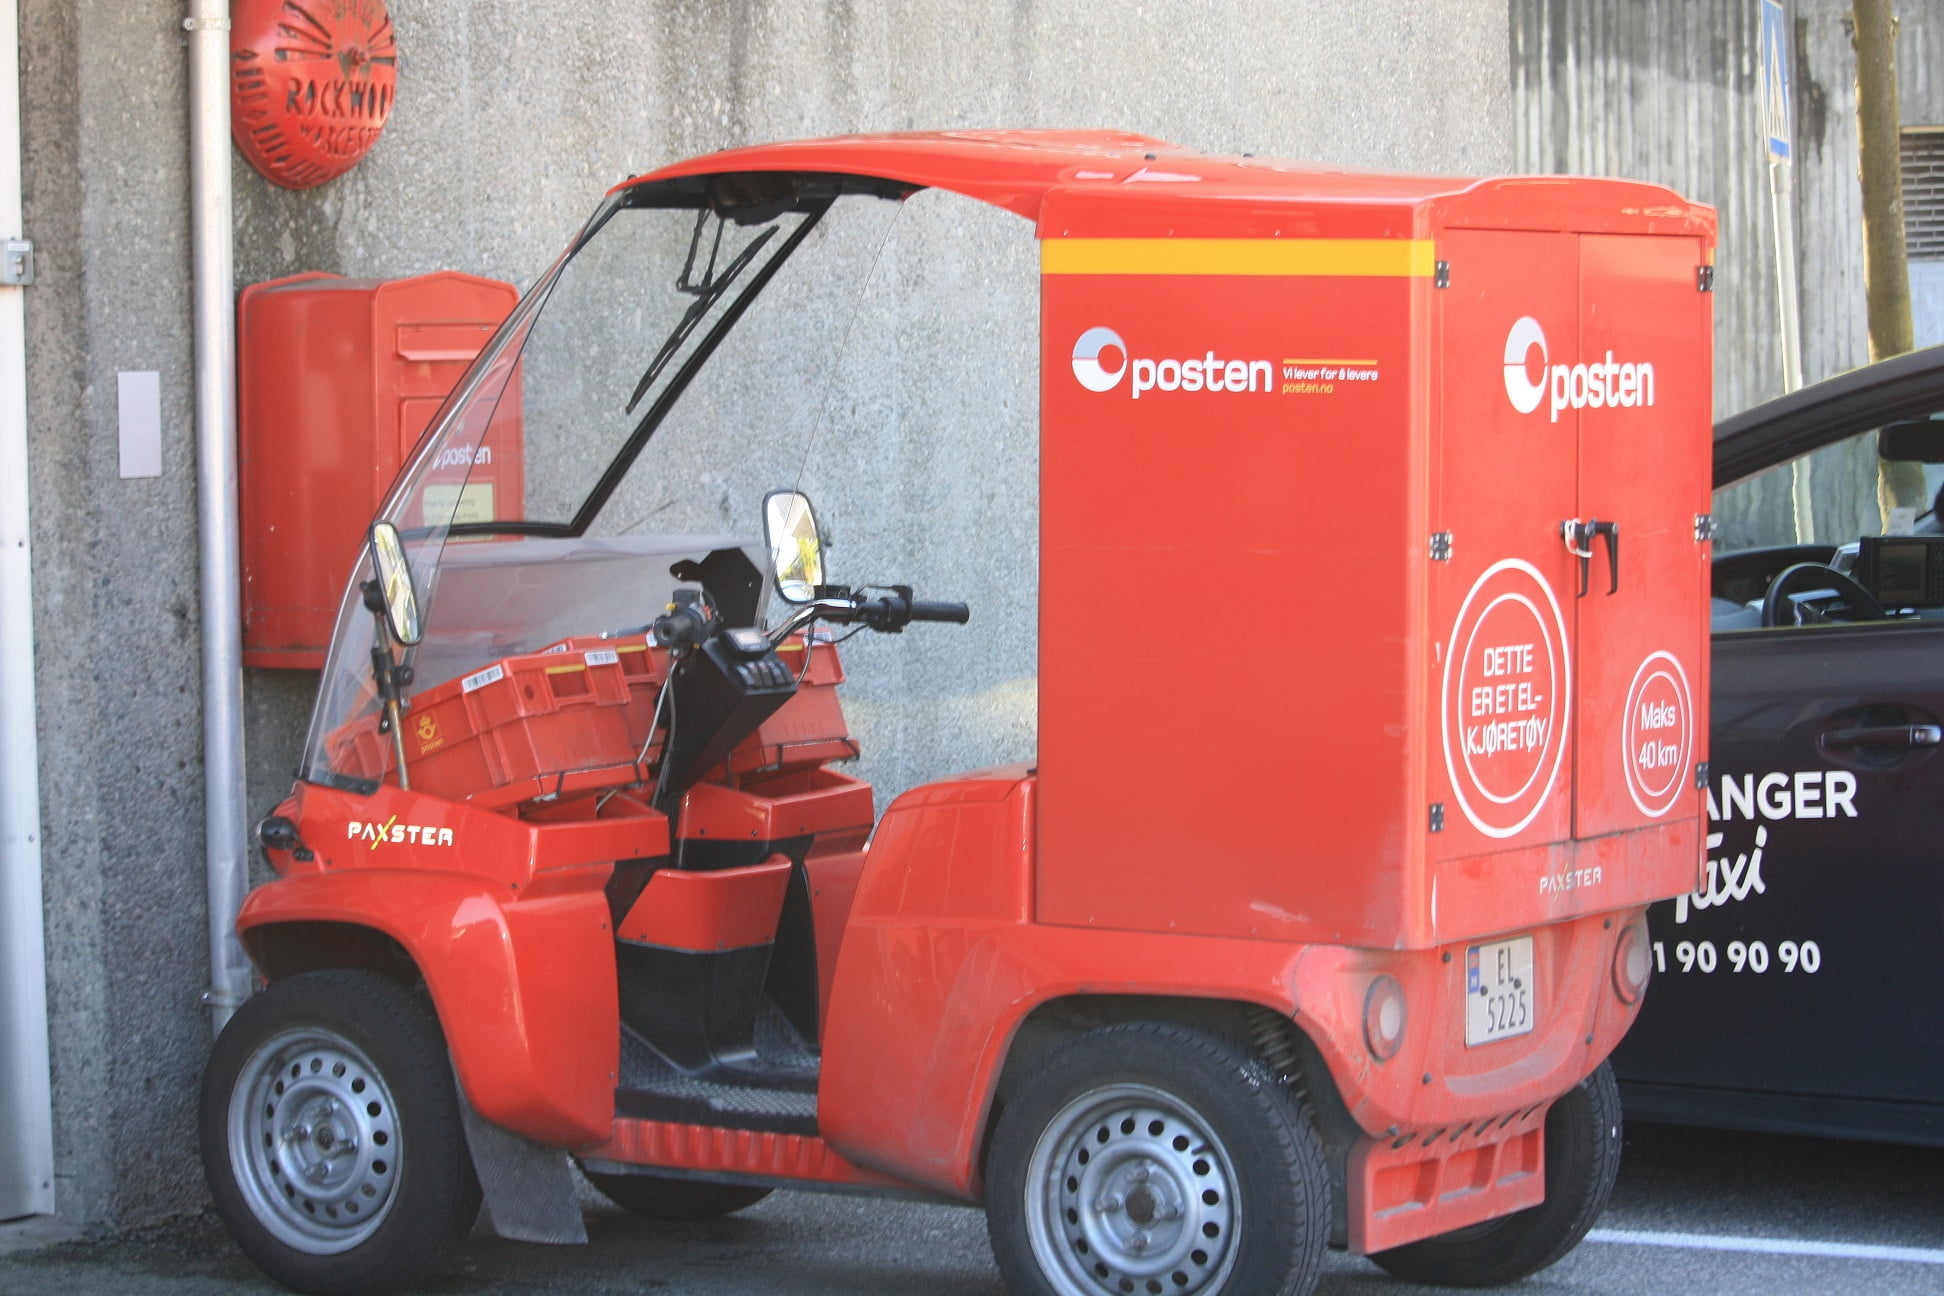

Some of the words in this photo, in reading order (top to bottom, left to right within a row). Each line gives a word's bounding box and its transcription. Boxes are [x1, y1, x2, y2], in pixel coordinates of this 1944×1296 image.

[1131, 350, 1273, 399] posten
[1282, 366, 1294, 380] Vi
[1294, 366, 1319, 380] lever
[1320, 367, 1338, 380] for
[1347, 367, 1379, 381] levere
[1282, 382, 1334, 395] posten.no
[1550, 349, 1655, 423] posten
[441, 443, 492, 470] posten
[1483, 644, 1534, 678] DETTE
[1471, 685, 1493, 717] ER
[1496, 683, 1515, 713] ET
[1517, 682, 1543, 711] EL-
[1641, 700, 1676, 731] Maks
[1466, 714, 1547, 758] KJØRETØY
[1638, 740, 1655, 770] 40
[1657, 741, 1678, 768] km
[347, 814, 454, 850] PAXSTER
[1539, 863, 1603, 902] PAXSTER
[1497, 947, 1514, 985] EL
[1675, 940, 1718, 974] 90
[1726, 940, 1770, 974] 90
[1778, 940, 1822, 974] 90
[1487, 990, 1527, 1034] 5225
